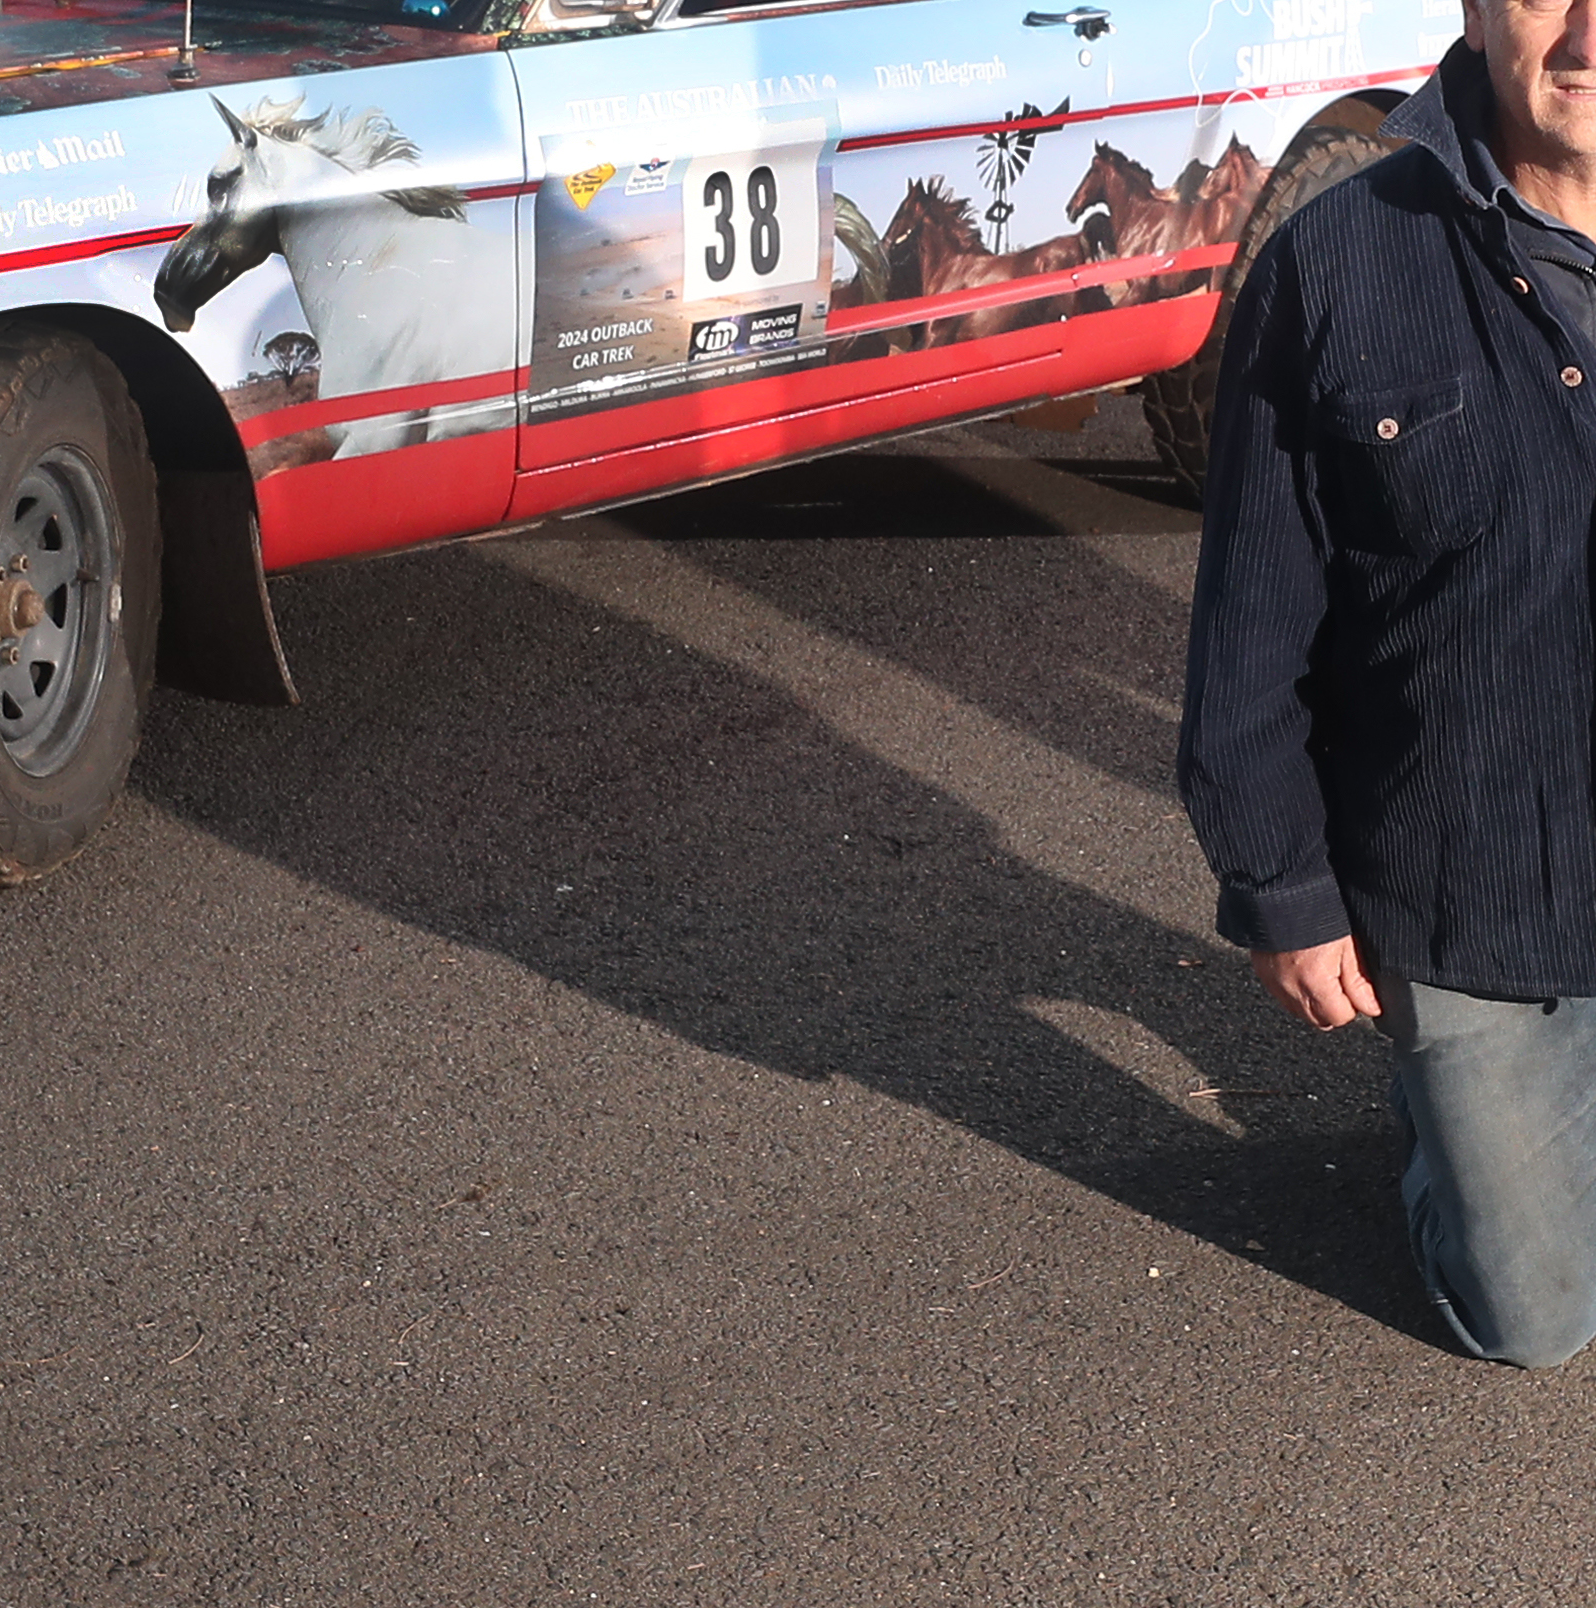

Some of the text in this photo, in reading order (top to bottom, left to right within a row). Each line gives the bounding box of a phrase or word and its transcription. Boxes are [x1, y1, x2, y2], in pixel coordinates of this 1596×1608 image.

[874, 54, 1007, 90] Daily Telegraph
[1235, 34, 1345, 87] SUMMIT
[565, 73, 818, 127] THE AUSTRALIAN
[53, 130, 126, 165] Mail
[17, 184, 138, 228] Telegraph
[703, 165, 781, 283] 38
[557, 318, 654, 349] 2024 OUTBACK
[749, 328, 795, 345] BRANDS
[751, 313, 798, 331] MOVING
[572, 345, 635, 370] CAR TREK
